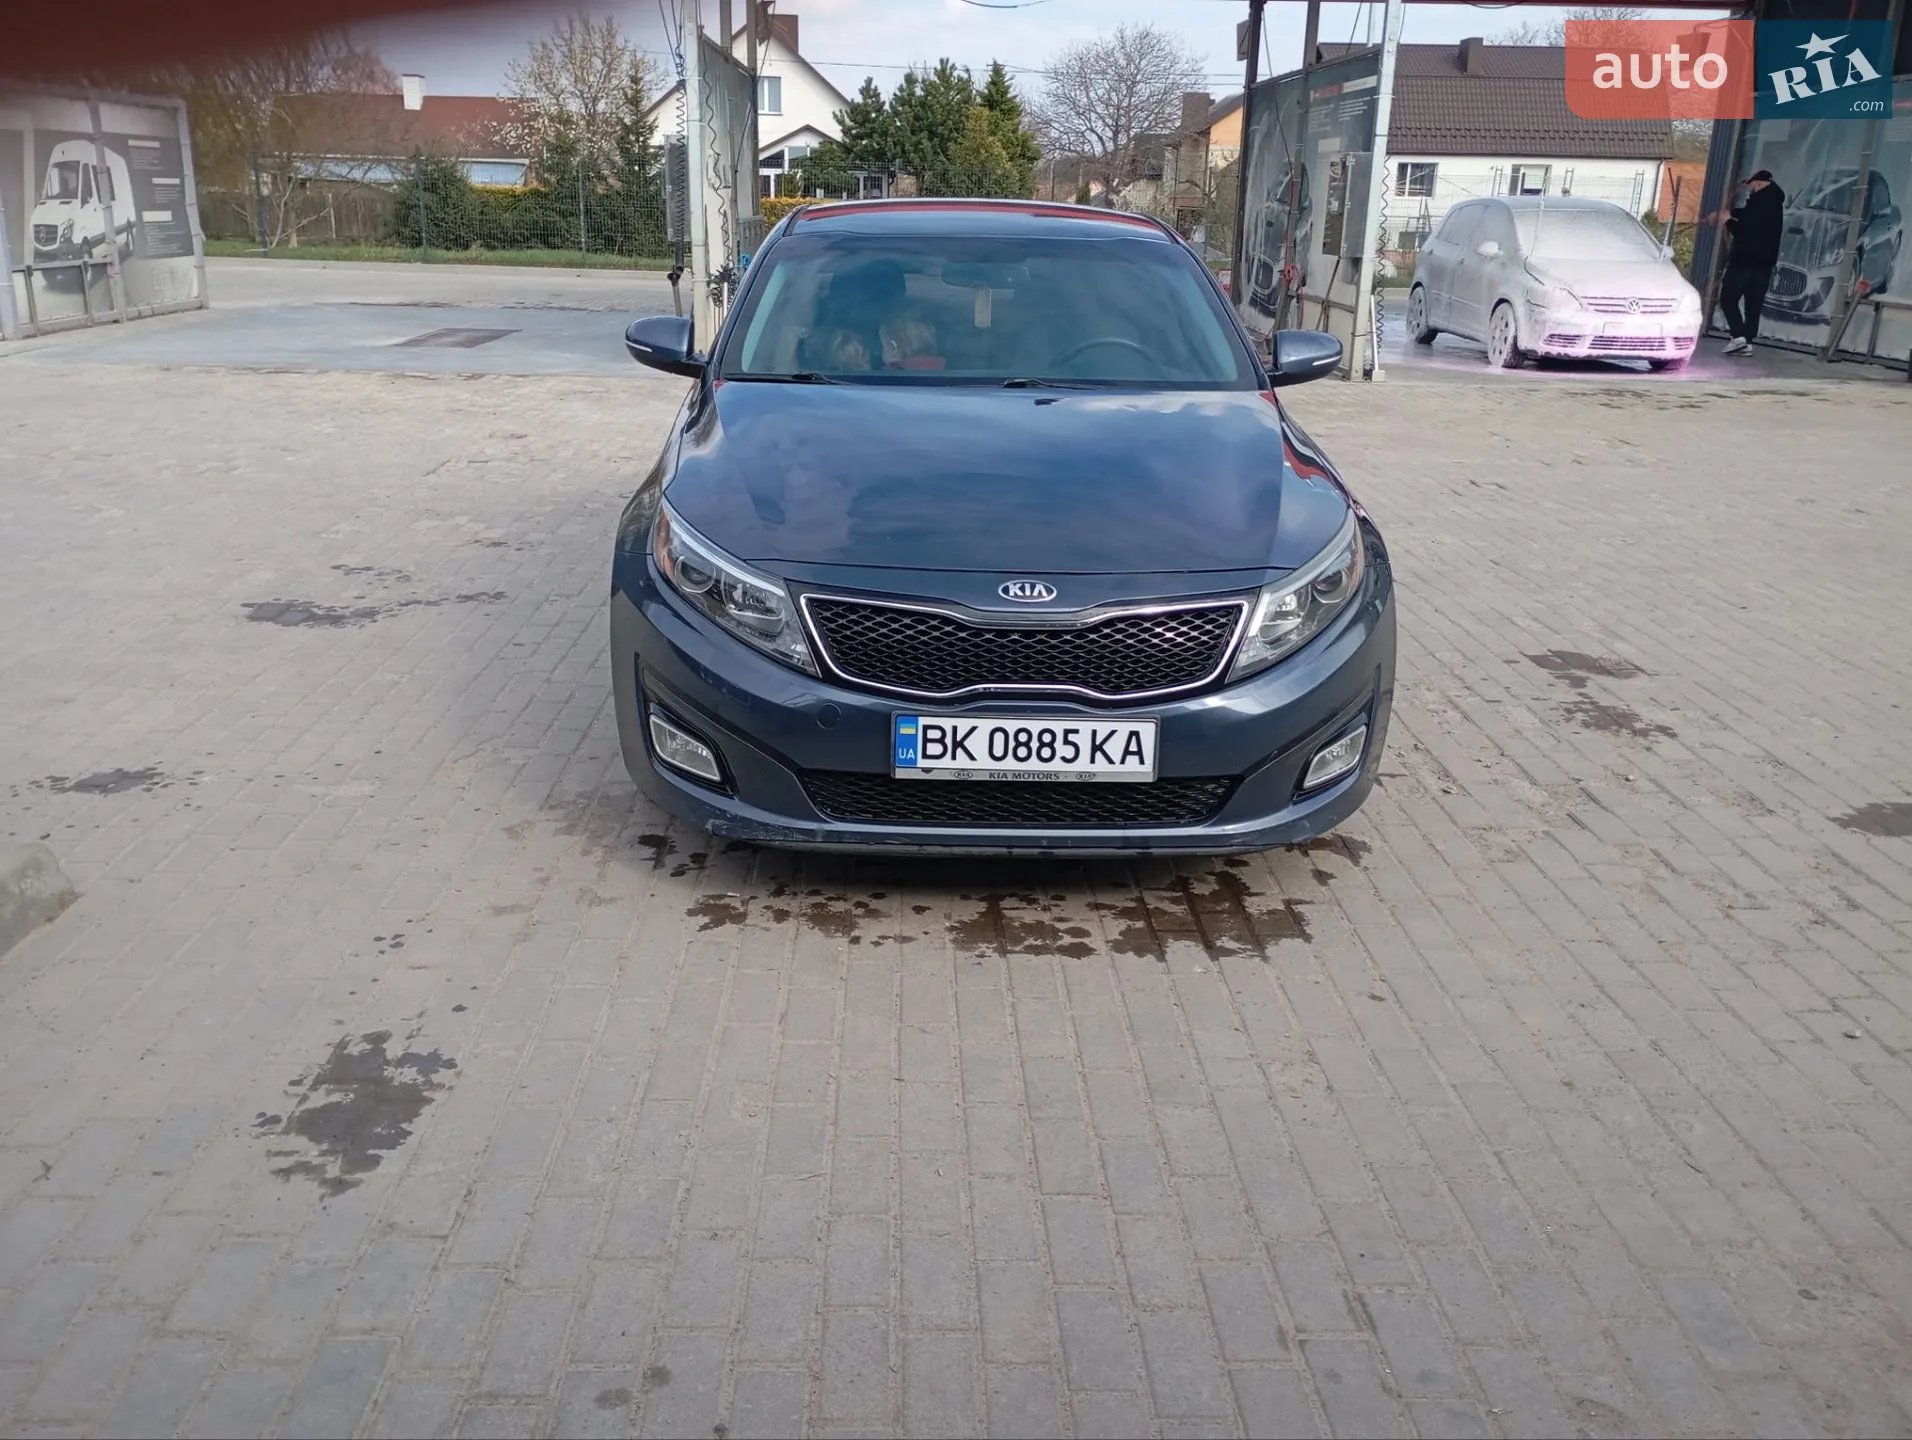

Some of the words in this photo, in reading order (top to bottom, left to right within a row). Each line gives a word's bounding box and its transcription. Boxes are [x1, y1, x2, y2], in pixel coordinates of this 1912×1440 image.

[1009, 583, 1048, 597] KIA
[921, 724, 979, 761] BK
[988, 726, 1080, 764] 0885
[1090, 728, 1145, 765] KA
[899, 748, 915, 760] UA
[1011, 772, 1060, 780] MOTORS
